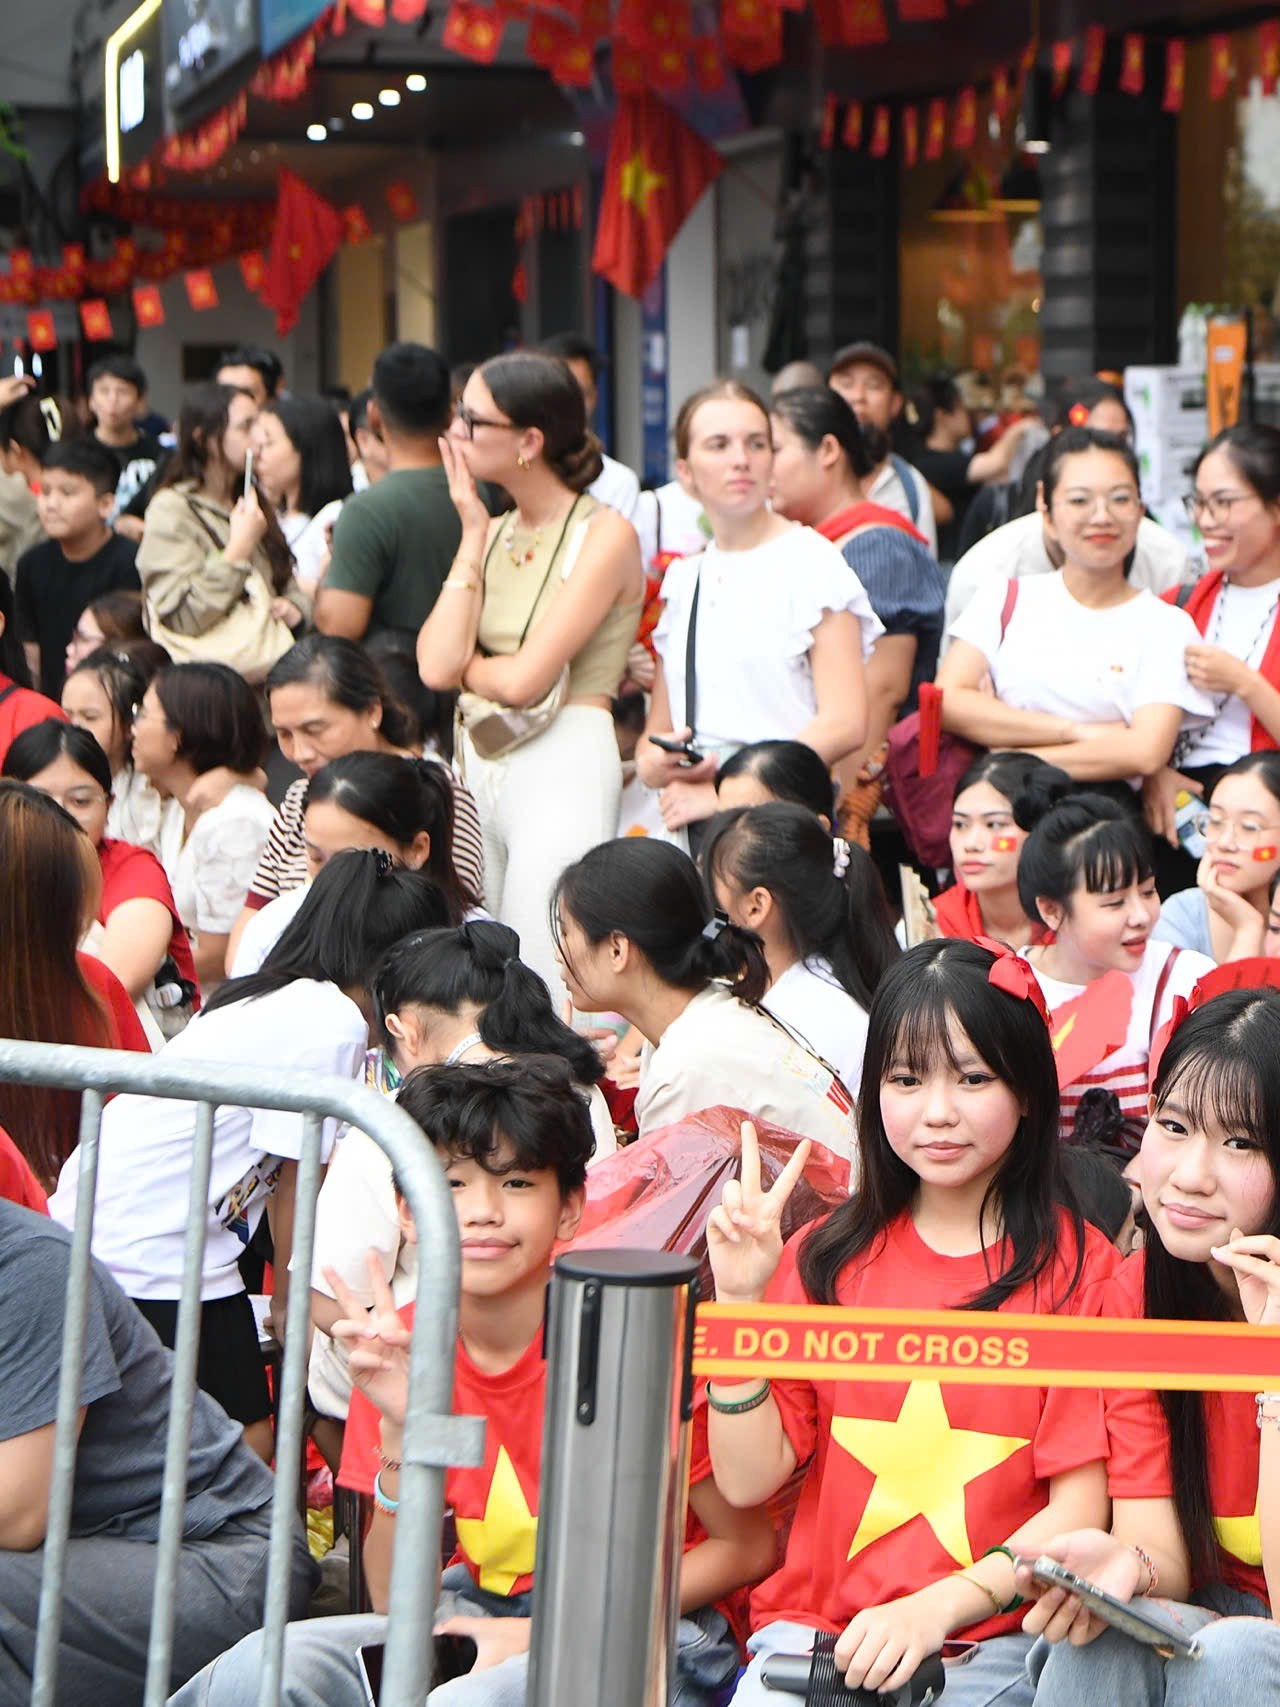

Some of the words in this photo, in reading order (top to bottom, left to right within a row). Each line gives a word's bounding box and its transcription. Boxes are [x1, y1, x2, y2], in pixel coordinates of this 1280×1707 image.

[734, 1327, 790, 1358] DO
[803, 1330, 884, 1362] NOT
[896, 1336, 1030, 1367] CROSS
